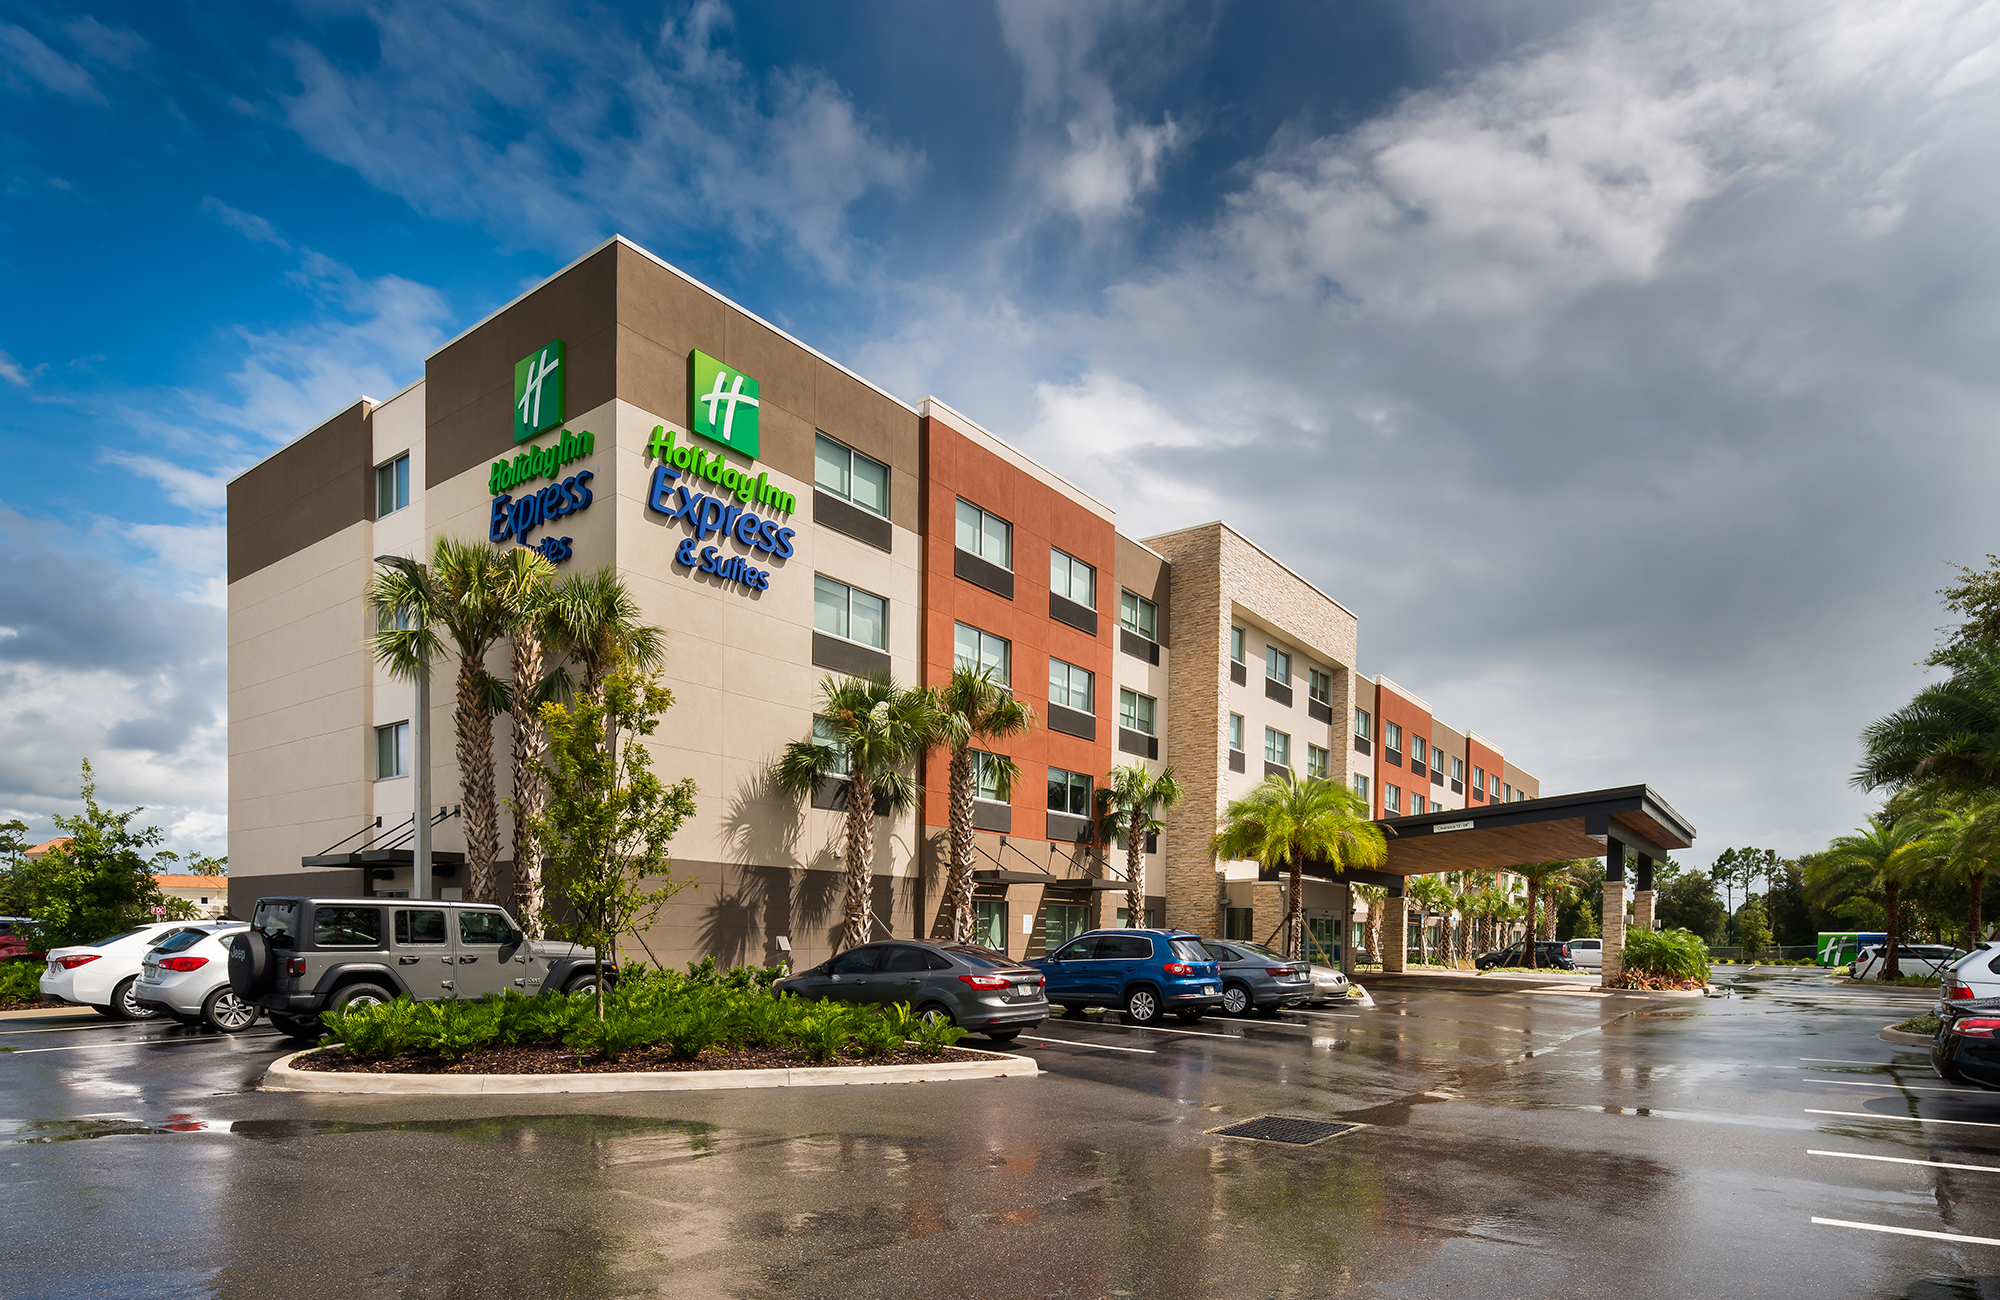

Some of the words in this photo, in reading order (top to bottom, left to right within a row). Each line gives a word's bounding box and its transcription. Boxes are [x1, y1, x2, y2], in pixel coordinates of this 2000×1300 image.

[488, 444, 560, 496] Holiday
[558, 428, 595, 466] Inn
[647, 425, 756, 502] Holiday
[755, 472, 796, 515] Inn
[489, 470, 594, 544] Express
[648, 465, 796, 559] Express
[675, 538, 697, 568] &
[698, 546, 770, 591] Suites
[230, 945, 246, 962] Jeep
